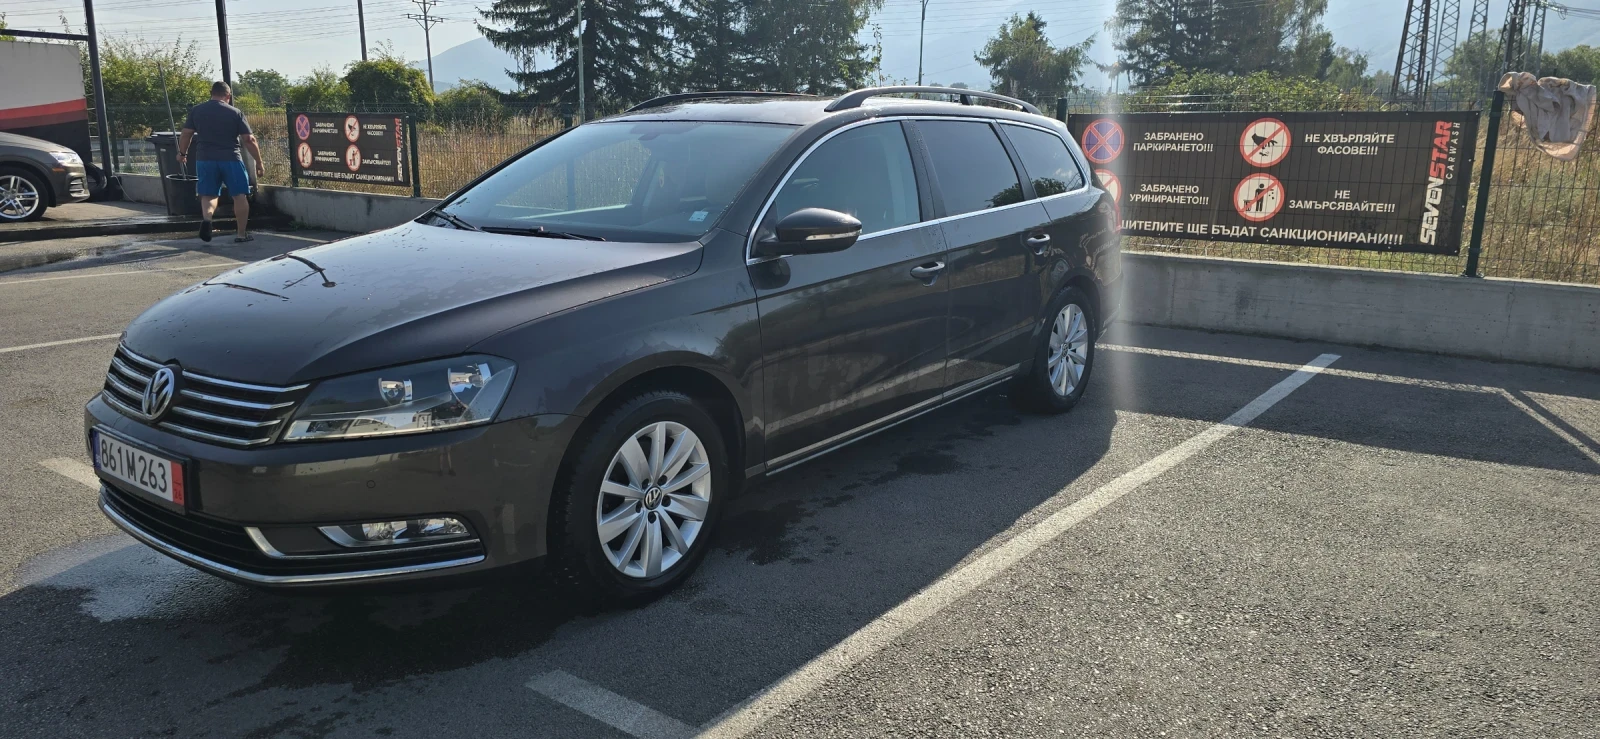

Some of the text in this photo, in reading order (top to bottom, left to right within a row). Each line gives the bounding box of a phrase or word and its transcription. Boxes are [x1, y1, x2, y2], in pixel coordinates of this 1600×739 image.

[1143, 132, 1204, 141] ЗАБРАНЕНО
[1304, 131, 1395, 143] НЕ ХВЪРЛЯЙТЕ
[1133, 142, 1214, 152] ПАРКИРАНЕТО!!!
[1317, 145, 1378, 155] ФАСОВЕ!!!
[1140, 184, 1200, 194] ЗАБРАНЕНО
[1129, 193, 1209, 205] УРИНИРАНЕТО!!!
[1334, 190, 1351, 199] НЕ
[1288, 200, 1395, 213] ЗАМЪРСЯВАЙТЕ!!!
[1187, 223, 1208, 235] ЩЕ
[1211, 224, 1257, 237] БЪДАТ
[1259, 226, 1404, 245] САНКЦИОНИРАНИ!!!
